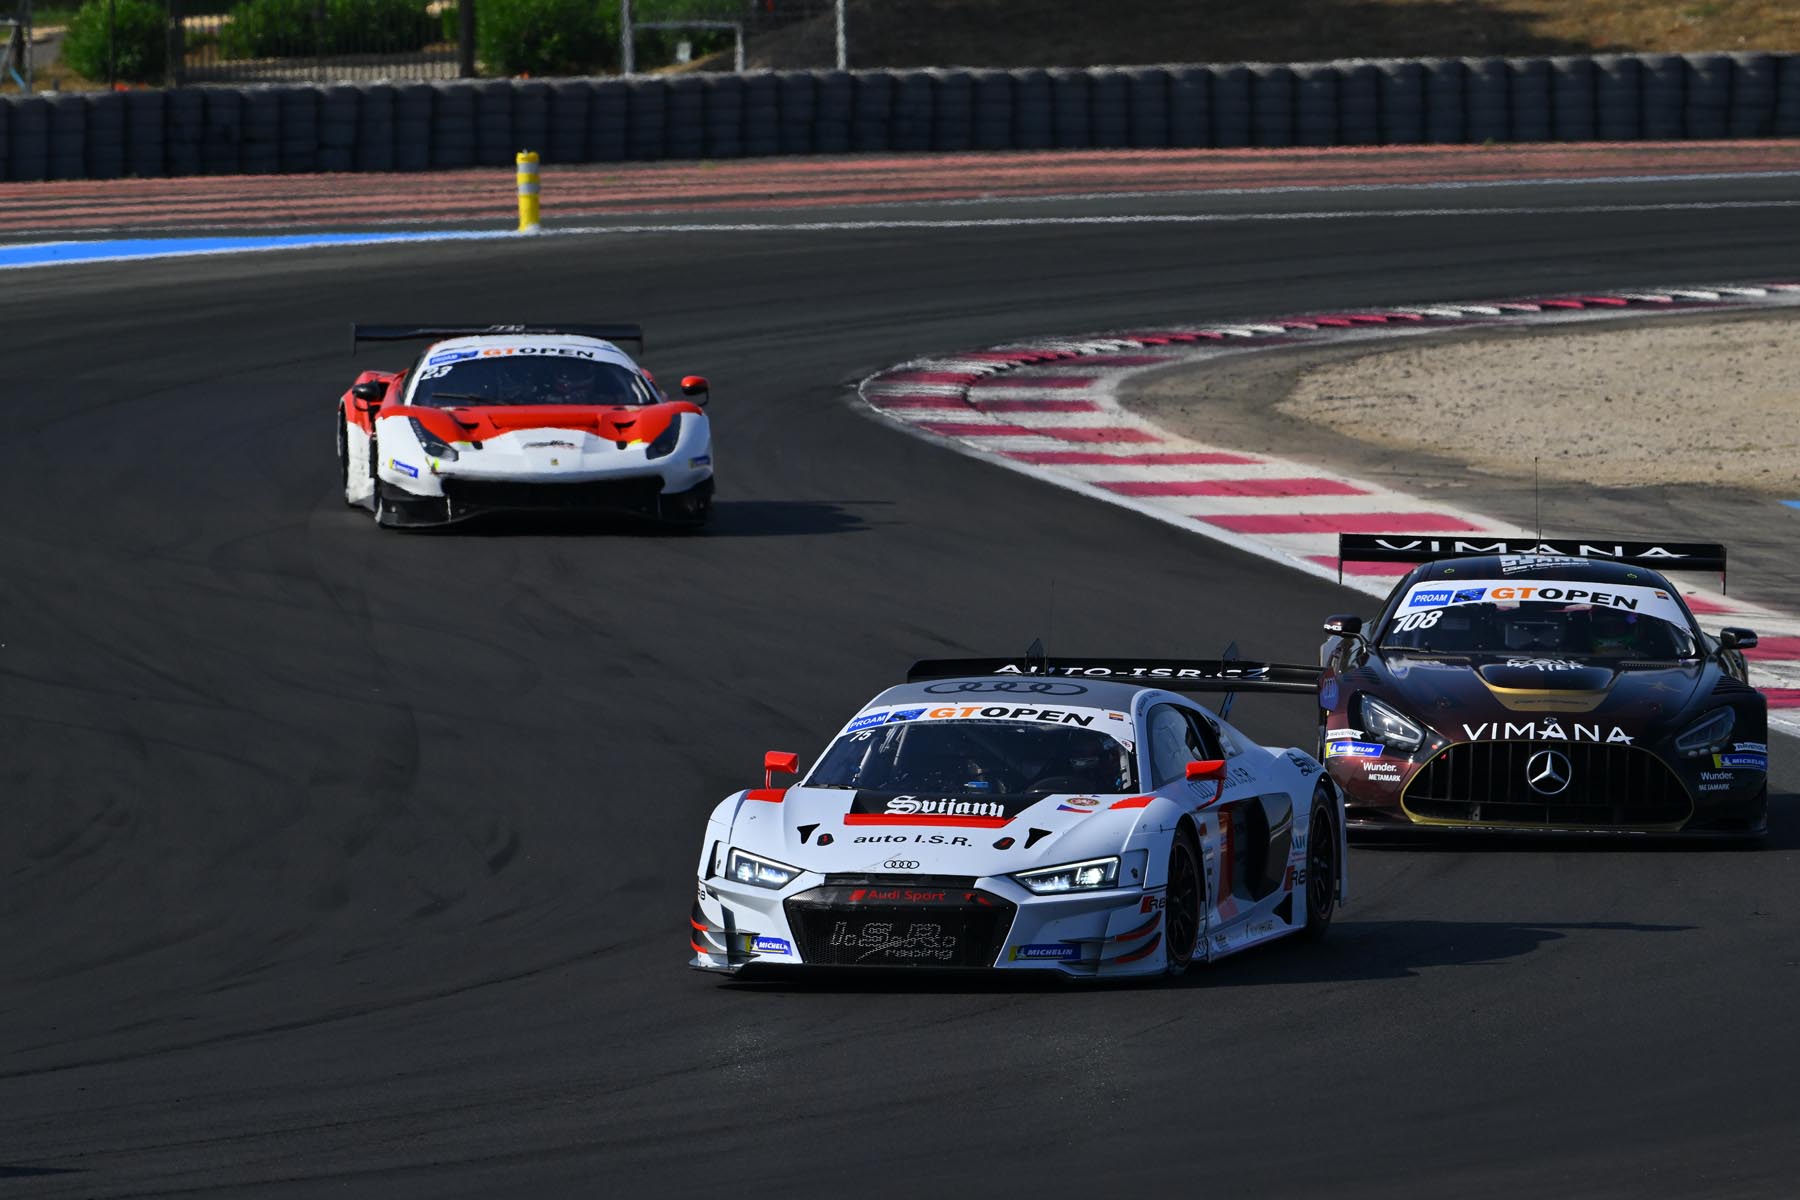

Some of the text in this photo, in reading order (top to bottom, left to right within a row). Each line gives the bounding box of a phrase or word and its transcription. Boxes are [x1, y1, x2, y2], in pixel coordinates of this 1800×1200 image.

[420, 366, 453, 380] 23
[1375, 539, 1691, 558] VIMANA
[1414, 594, 1448, 603] PROAM
[1393, 610, 1443, 634] 108
[850, 715, 886, 729] PROAM
[850, 730, 875, 743] 75
[1462, 722, 1635, 745] VIMANA
[1363, 762, 1397, 772] Wunder.
[1368, 773, 1401, 782] METAMARK
[1700, 771, 1734, 780] Wunder.
[1698, 783, 1730, 791] METAMARK
[884, 795, 1004, 817] Svijany
[853, 834, 973, 847] auto I.S.R.
[867, 889, 946, 901] Audi Sport
[1027, 948, 1073, 956] MICHELIN
